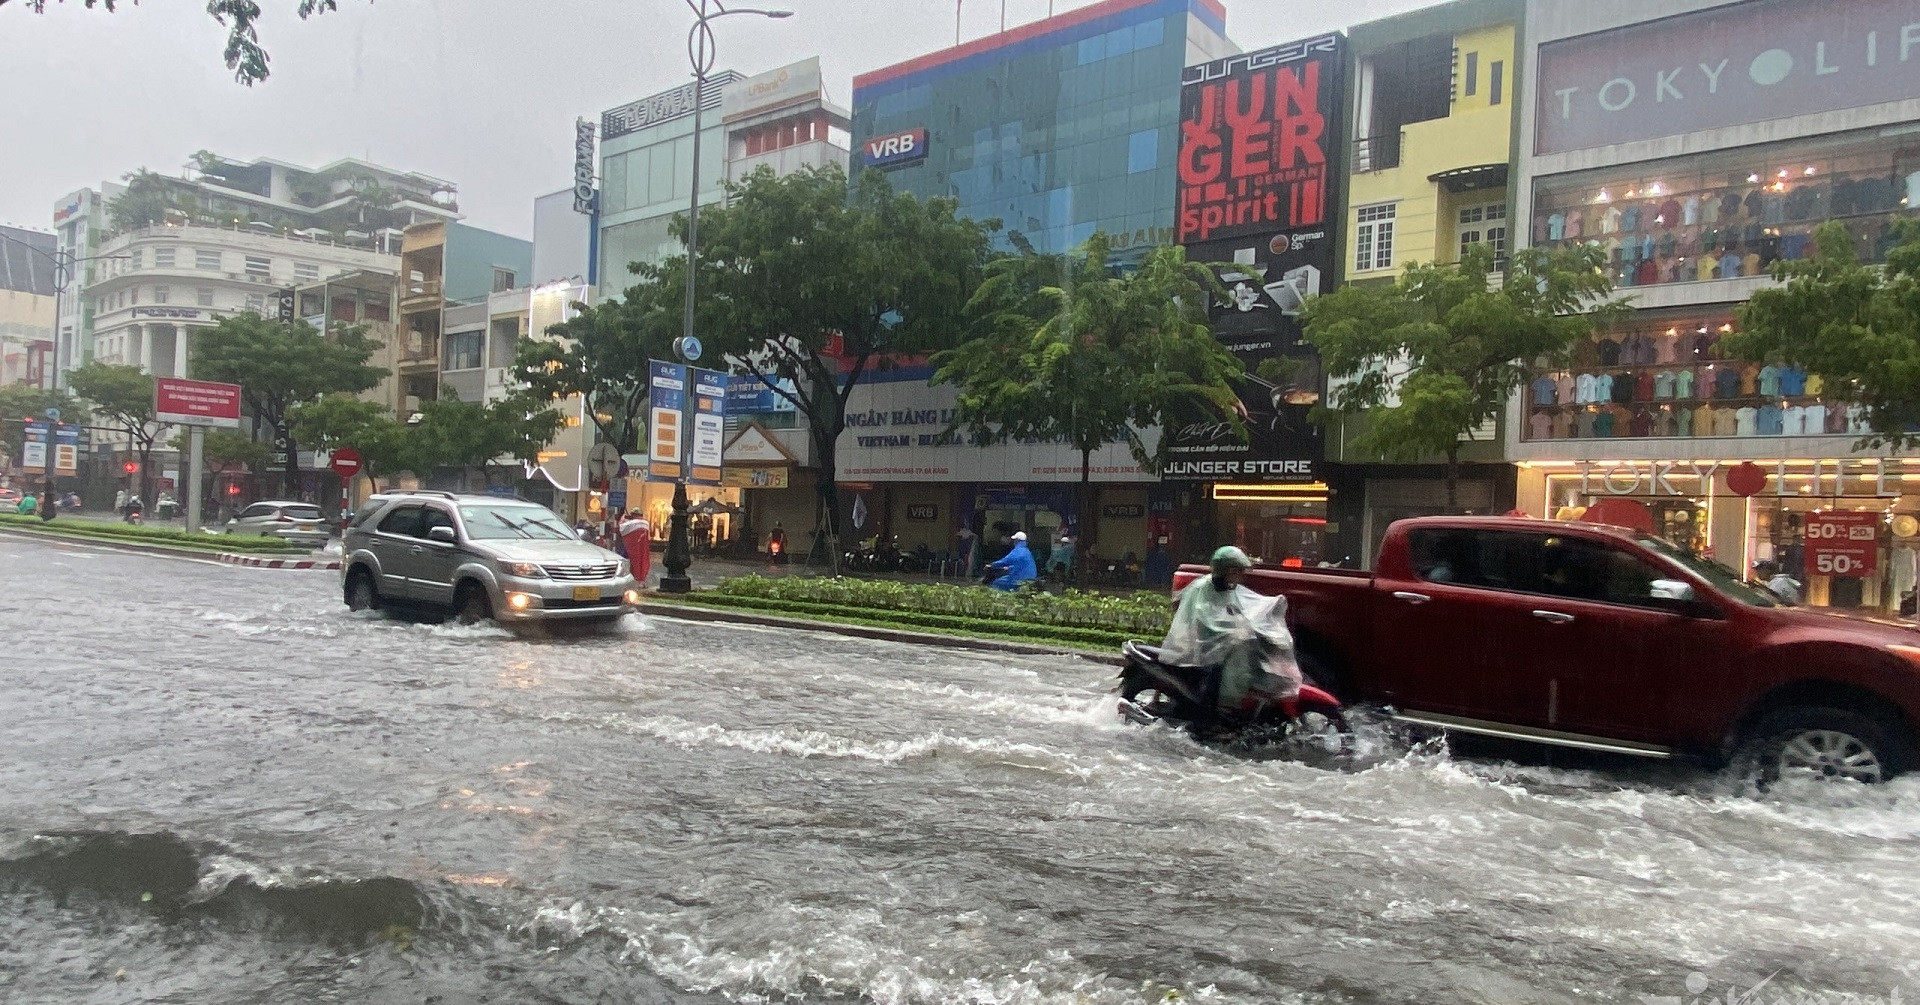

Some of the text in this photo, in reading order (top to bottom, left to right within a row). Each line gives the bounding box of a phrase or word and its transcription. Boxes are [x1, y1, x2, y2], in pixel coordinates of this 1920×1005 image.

[1816, 22, 1920, 76] LIF
[1182, 60, 1320, 135] JUN
[871, 134, 915, 159] VRB
[1179, 112, 1325, 186] GER
[1291, 230, 1324, 242] German
[1225, 341, 1272, 352] w.junger.vn
[857, 435, 910, 447] VIETNAM
[1243, 460, 1312, 473] STORE
[1776, 459, 1903, 498] LIFE
[911, 506, 934, 518] VRB
[1108, 506, 1138, 516] VRB
[1817, 554, 1863, 573] 50%
